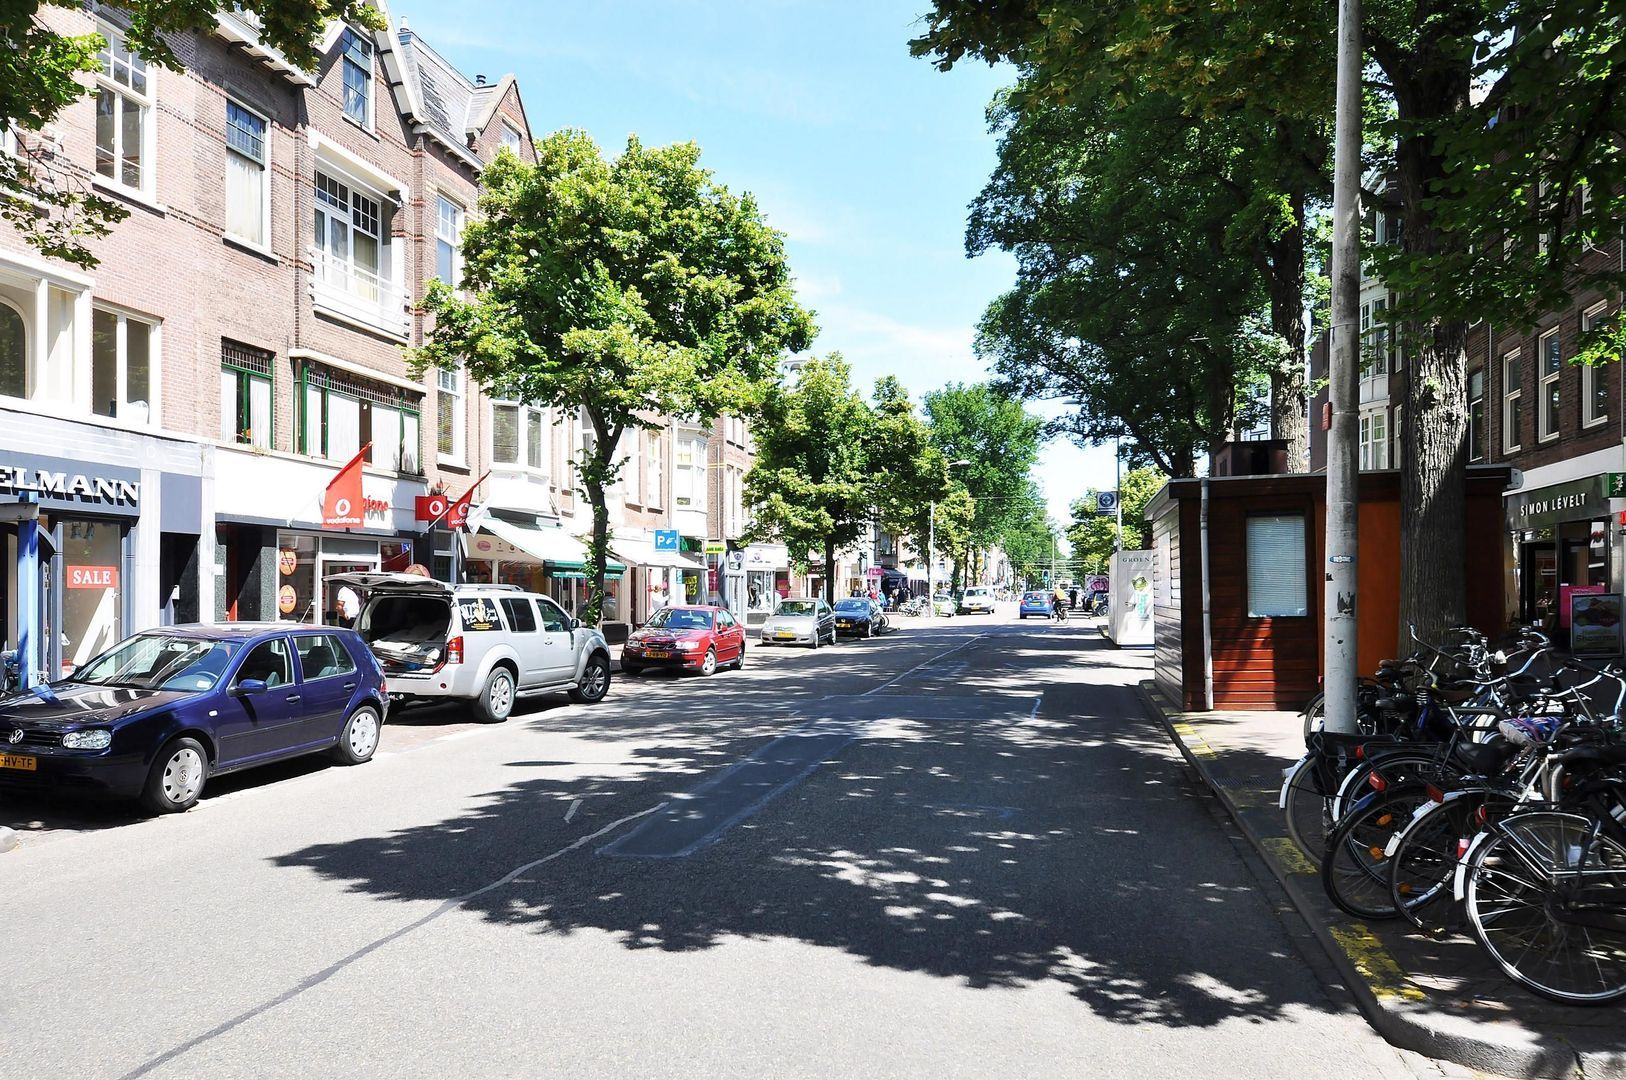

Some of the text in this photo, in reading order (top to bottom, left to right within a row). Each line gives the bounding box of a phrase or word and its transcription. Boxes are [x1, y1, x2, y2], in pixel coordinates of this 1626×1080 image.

[1520, 493, 1586, 517] SIMON LÉVELT
[73, 570, 111, 584] SALE
